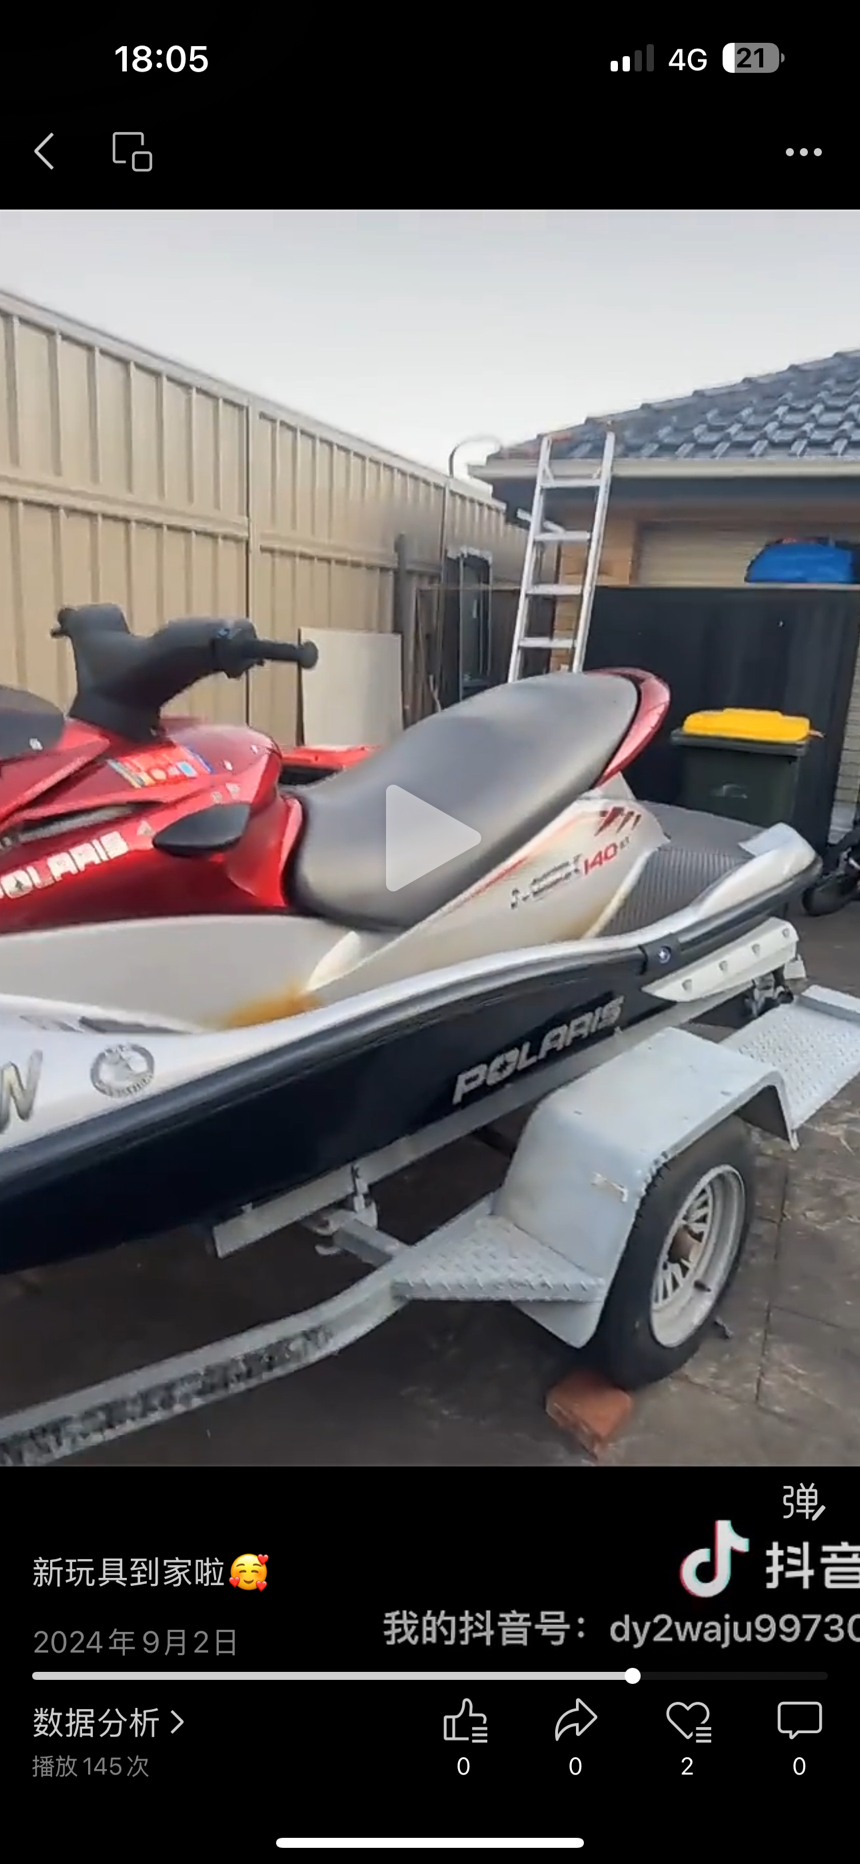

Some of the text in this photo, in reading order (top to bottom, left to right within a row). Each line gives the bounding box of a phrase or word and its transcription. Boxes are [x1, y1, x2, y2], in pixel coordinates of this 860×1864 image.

[115, 45, 208, 73] 18:05
[669, 48, 708, 71] 4G
[736, 47, 764, 68] 21
[0, 830, 129, 899] OLARIS
[583, 842, 618, 875] 140
[452, 994, 625, 1105] POLARIS
[33, 1557, 225, 1588] 新玩具到家啦
[33, 1708, 160, 1738] 数据分析
[457, 1757, 471, 1776] 0
[569, 1757, 583, 1776] 0
[681, 1757, 694, 1776] 2
[793, 1757, 807, 1776] 0
